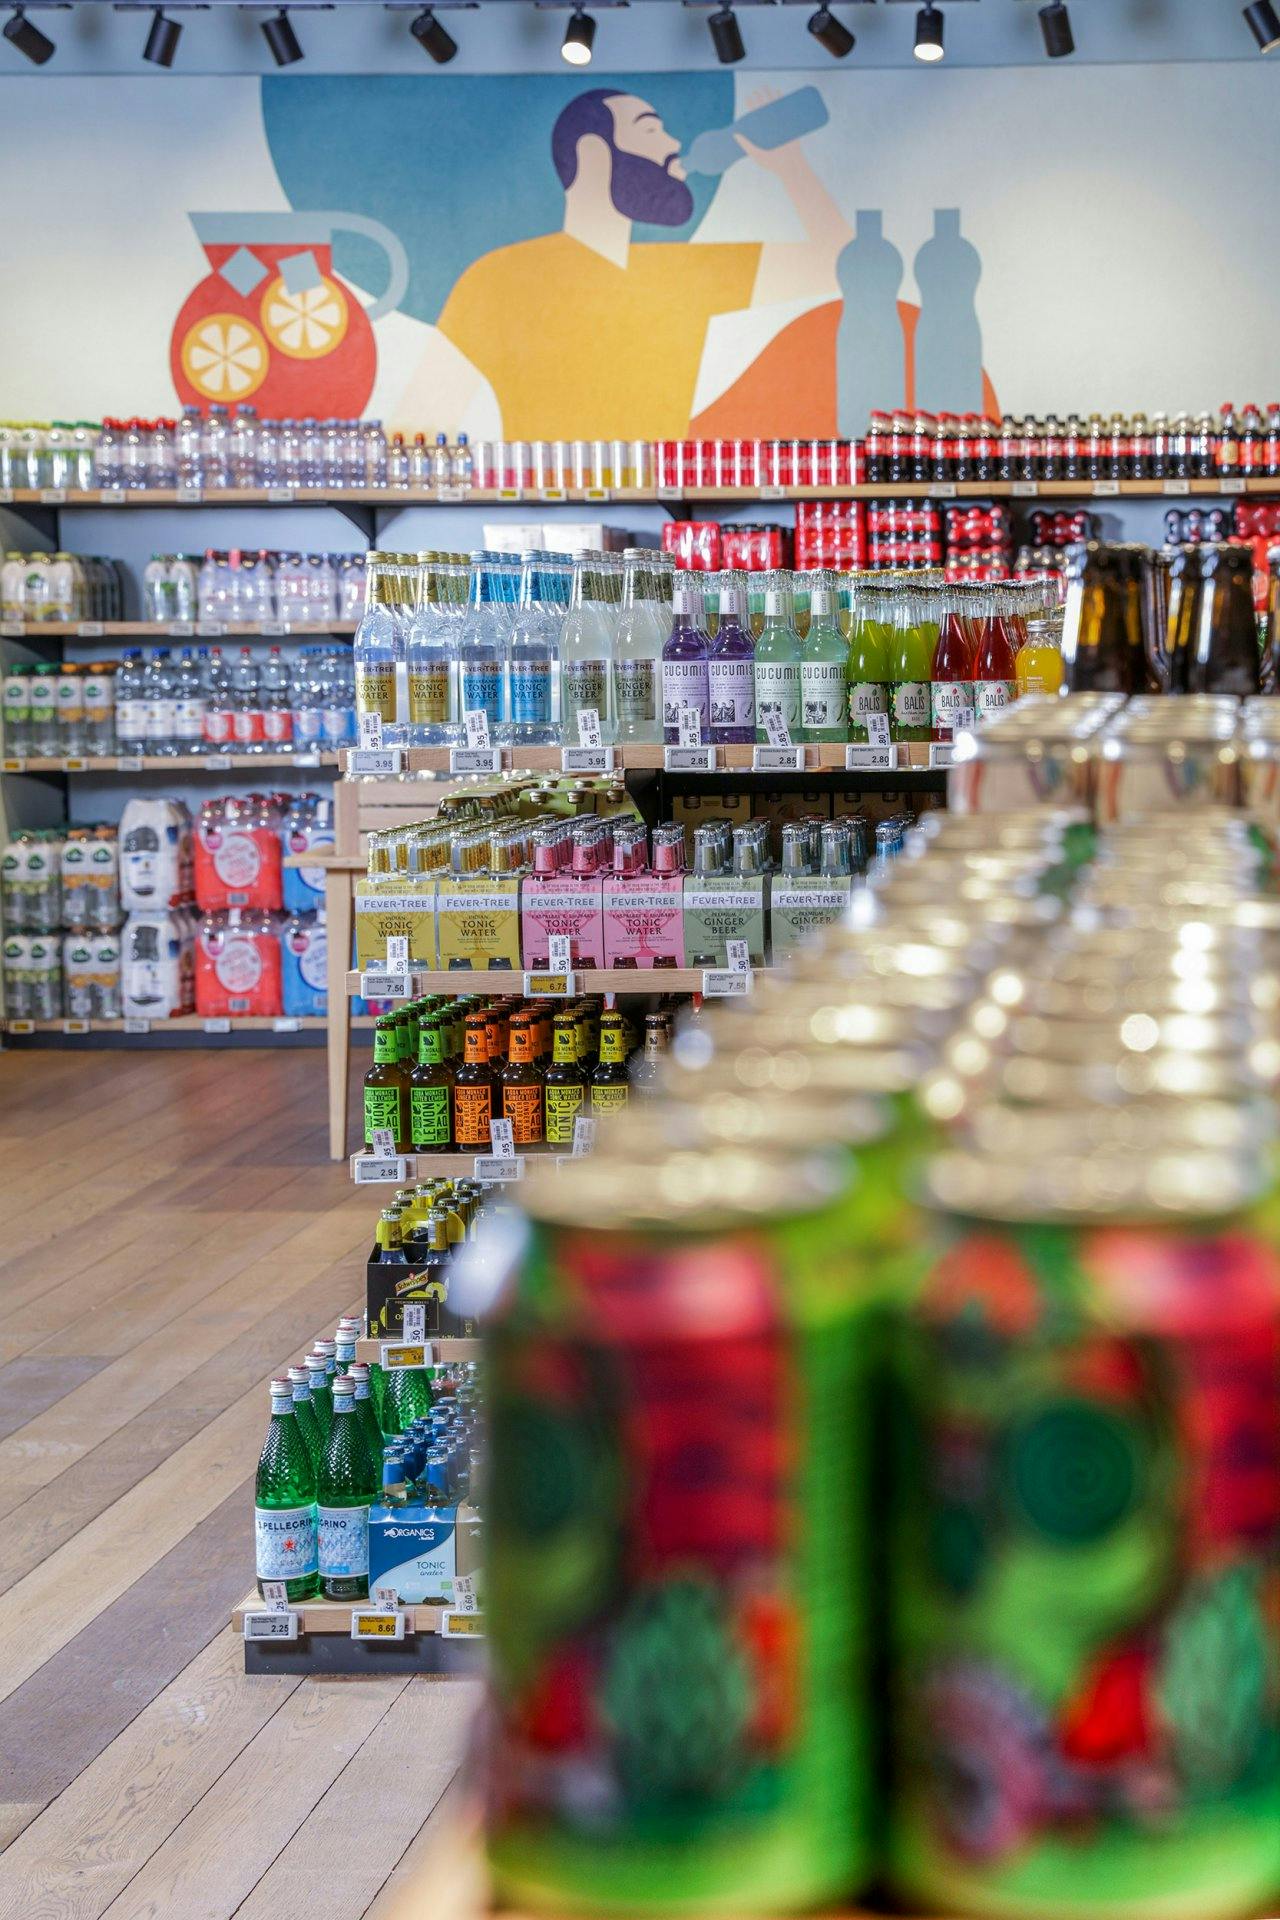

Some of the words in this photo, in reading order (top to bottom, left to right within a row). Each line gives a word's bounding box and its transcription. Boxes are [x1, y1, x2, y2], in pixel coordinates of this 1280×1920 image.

[564, 664, 606, 672] FEVER-TREE
[664, 666, 706, 677] CUCUMIS
[711, 664, 753, 676] CUCUMIS
[574, 691, 597, 699] BEER
[622, 690, 645, 698] BEER
[859, 696, 880, 711] BALIS
[904, 696, 925, 710] BALIS
[941, 695, 960, 708] BALIS
[986, 694, 1004, 707] BALIS
[588, 758, 606, 766] 3.95
[446, 899, 510, 907] FEVER-TREE
[531, 898, 595, 907] FEVER-TREE
[612, 897, 675, 906] FEVER-TREE
[692, 896, 756, 905] FEVER-TREE
[780, 895, 843, 904] FEVER-TREE
[364, 900, 428, 908] FEVER-TREE
[462, 920, 495, 928] TONIC
[546, 920, 580, 928] TONIC
[627, 919, 660, 927] TONIC
[704, 918, 745, 926] GINGER
[791, 916, 832, 925] GINGER
[379, 921, 413, 929] TONIC
[379, 930, 414, 938] WATER
[461, 929, 497, 937] WATER
[545, 928, 581, 936] WATER
[728, 982, 746, 990] 7.50
[423, 1103, 436, 1142] LEMON
[558, 1102, 571, 1140] TONIC
[389, 1528, 435, 1538] ORGANICS
[416, 1562, 445, 1570] TONIC
[465, 1595, 474, 1611] 9.60
[271, 1625, 289, 1633] 2.25
[378, 1624, 396, 1632] 8.60
